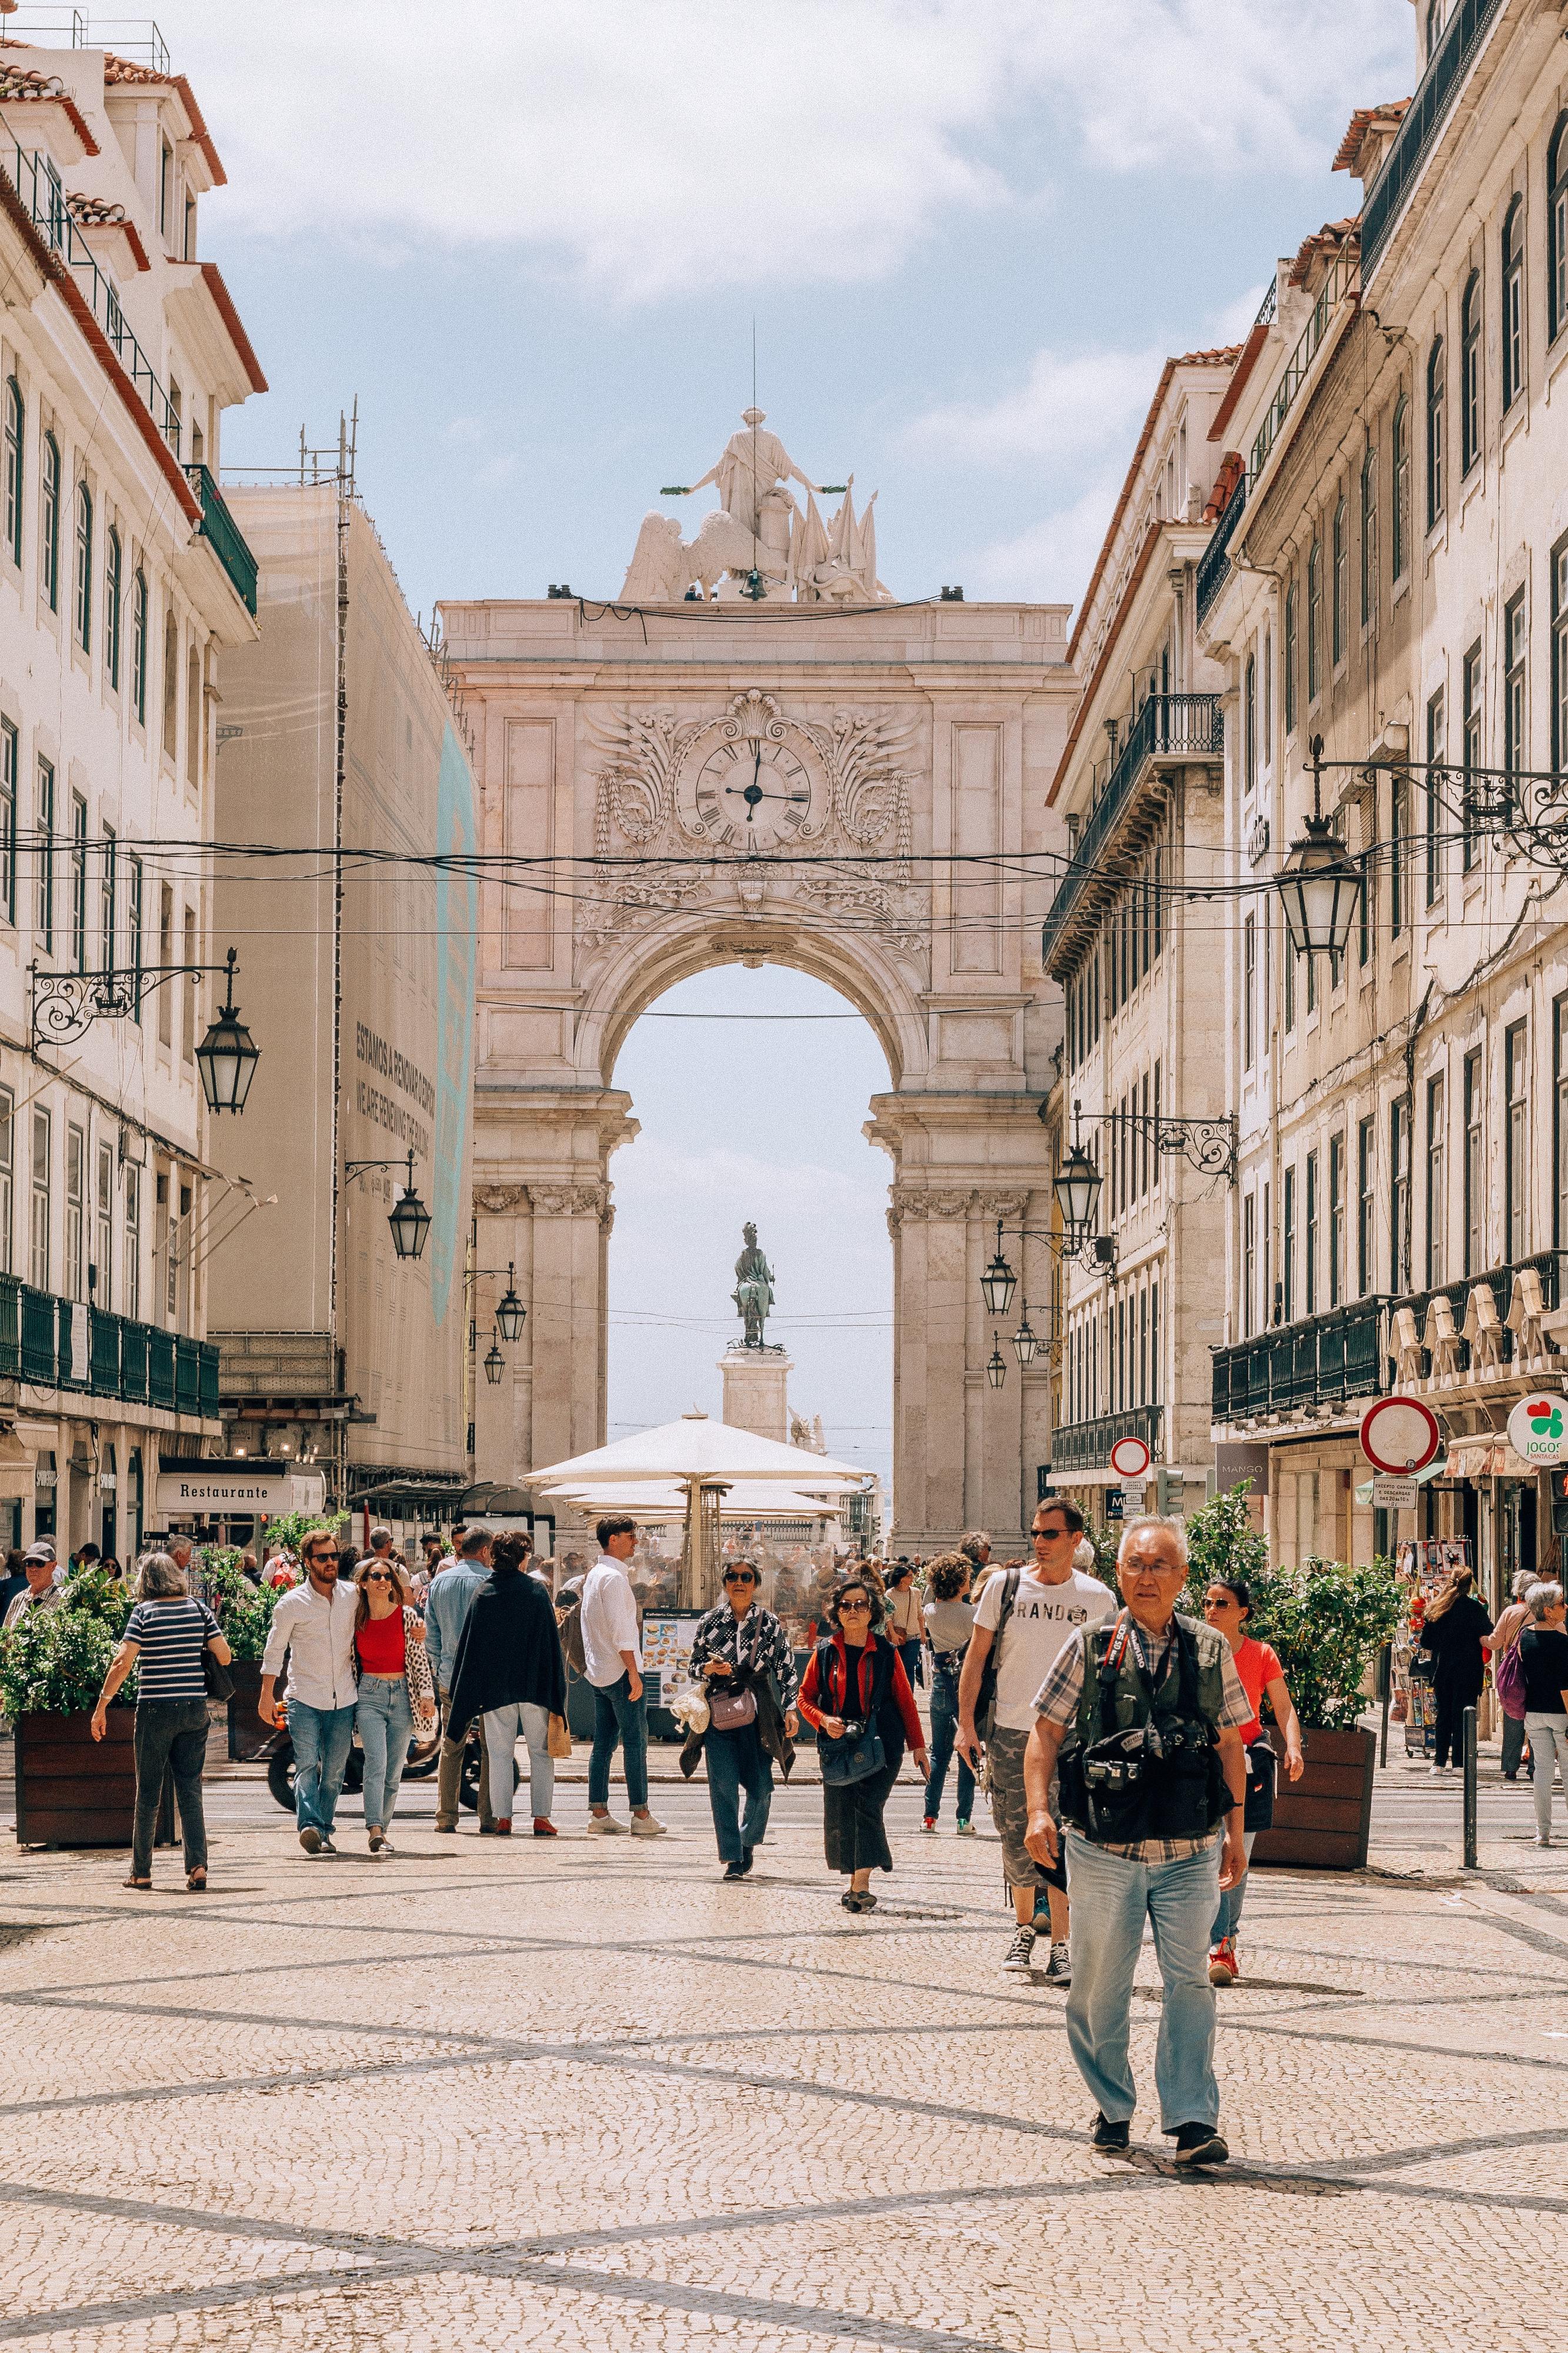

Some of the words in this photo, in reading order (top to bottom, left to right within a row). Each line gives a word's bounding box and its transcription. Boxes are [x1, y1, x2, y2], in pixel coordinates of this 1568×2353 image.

[356, 1021, 388, 1077] ESTAMOS
[388, 1045, 393, 1082] A
[394, 1049, 418, 1102] RENOVAR
[356, 1078, 366, 1115] WE
[366, 1085, 379, 1124] ARE
[379, 1092, 406, 1141] RENEWING
[180, 1484, 268, 1498] Restaurante
[1116, 1624, 1127, 1640] EOS
